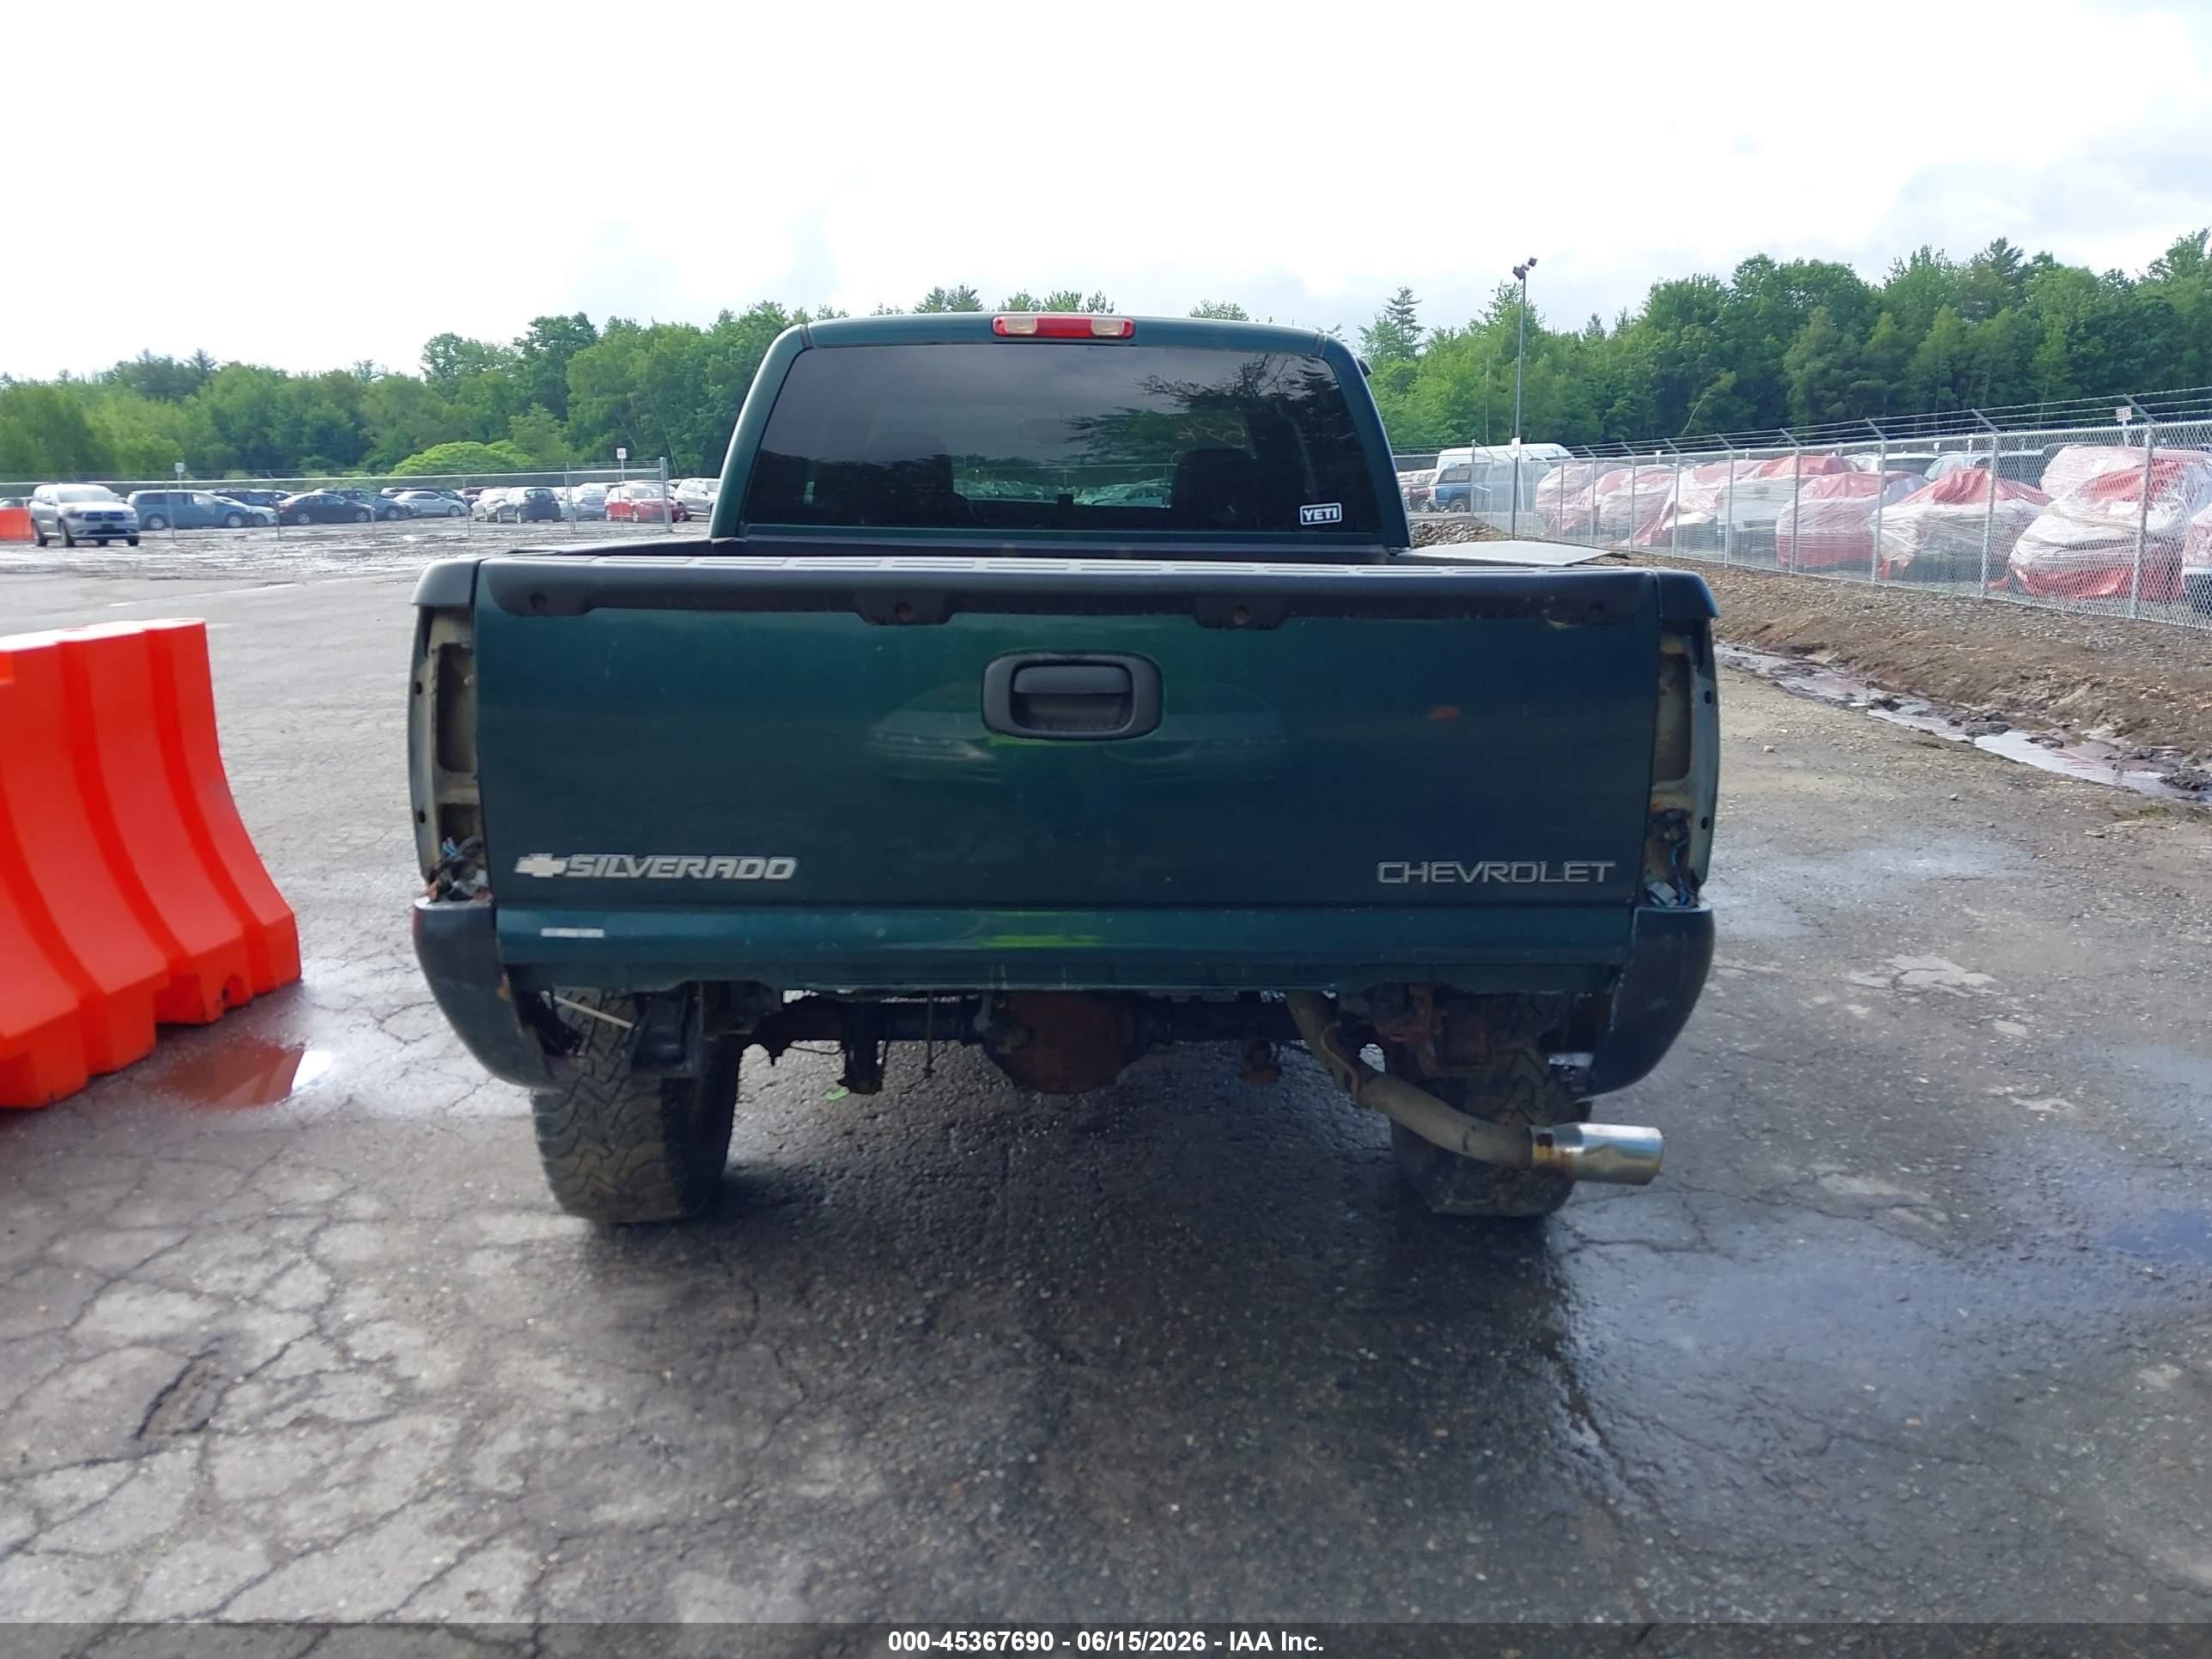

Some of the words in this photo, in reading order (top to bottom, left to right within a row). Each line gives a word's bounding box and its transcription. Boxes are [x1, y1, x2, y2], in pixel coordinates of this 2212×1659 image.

[1303, 507, 1338, 521] YETI
[565, 854, 798, 880] SILVERADO
[1377, 860, 1616, 884] CHEVROLET
